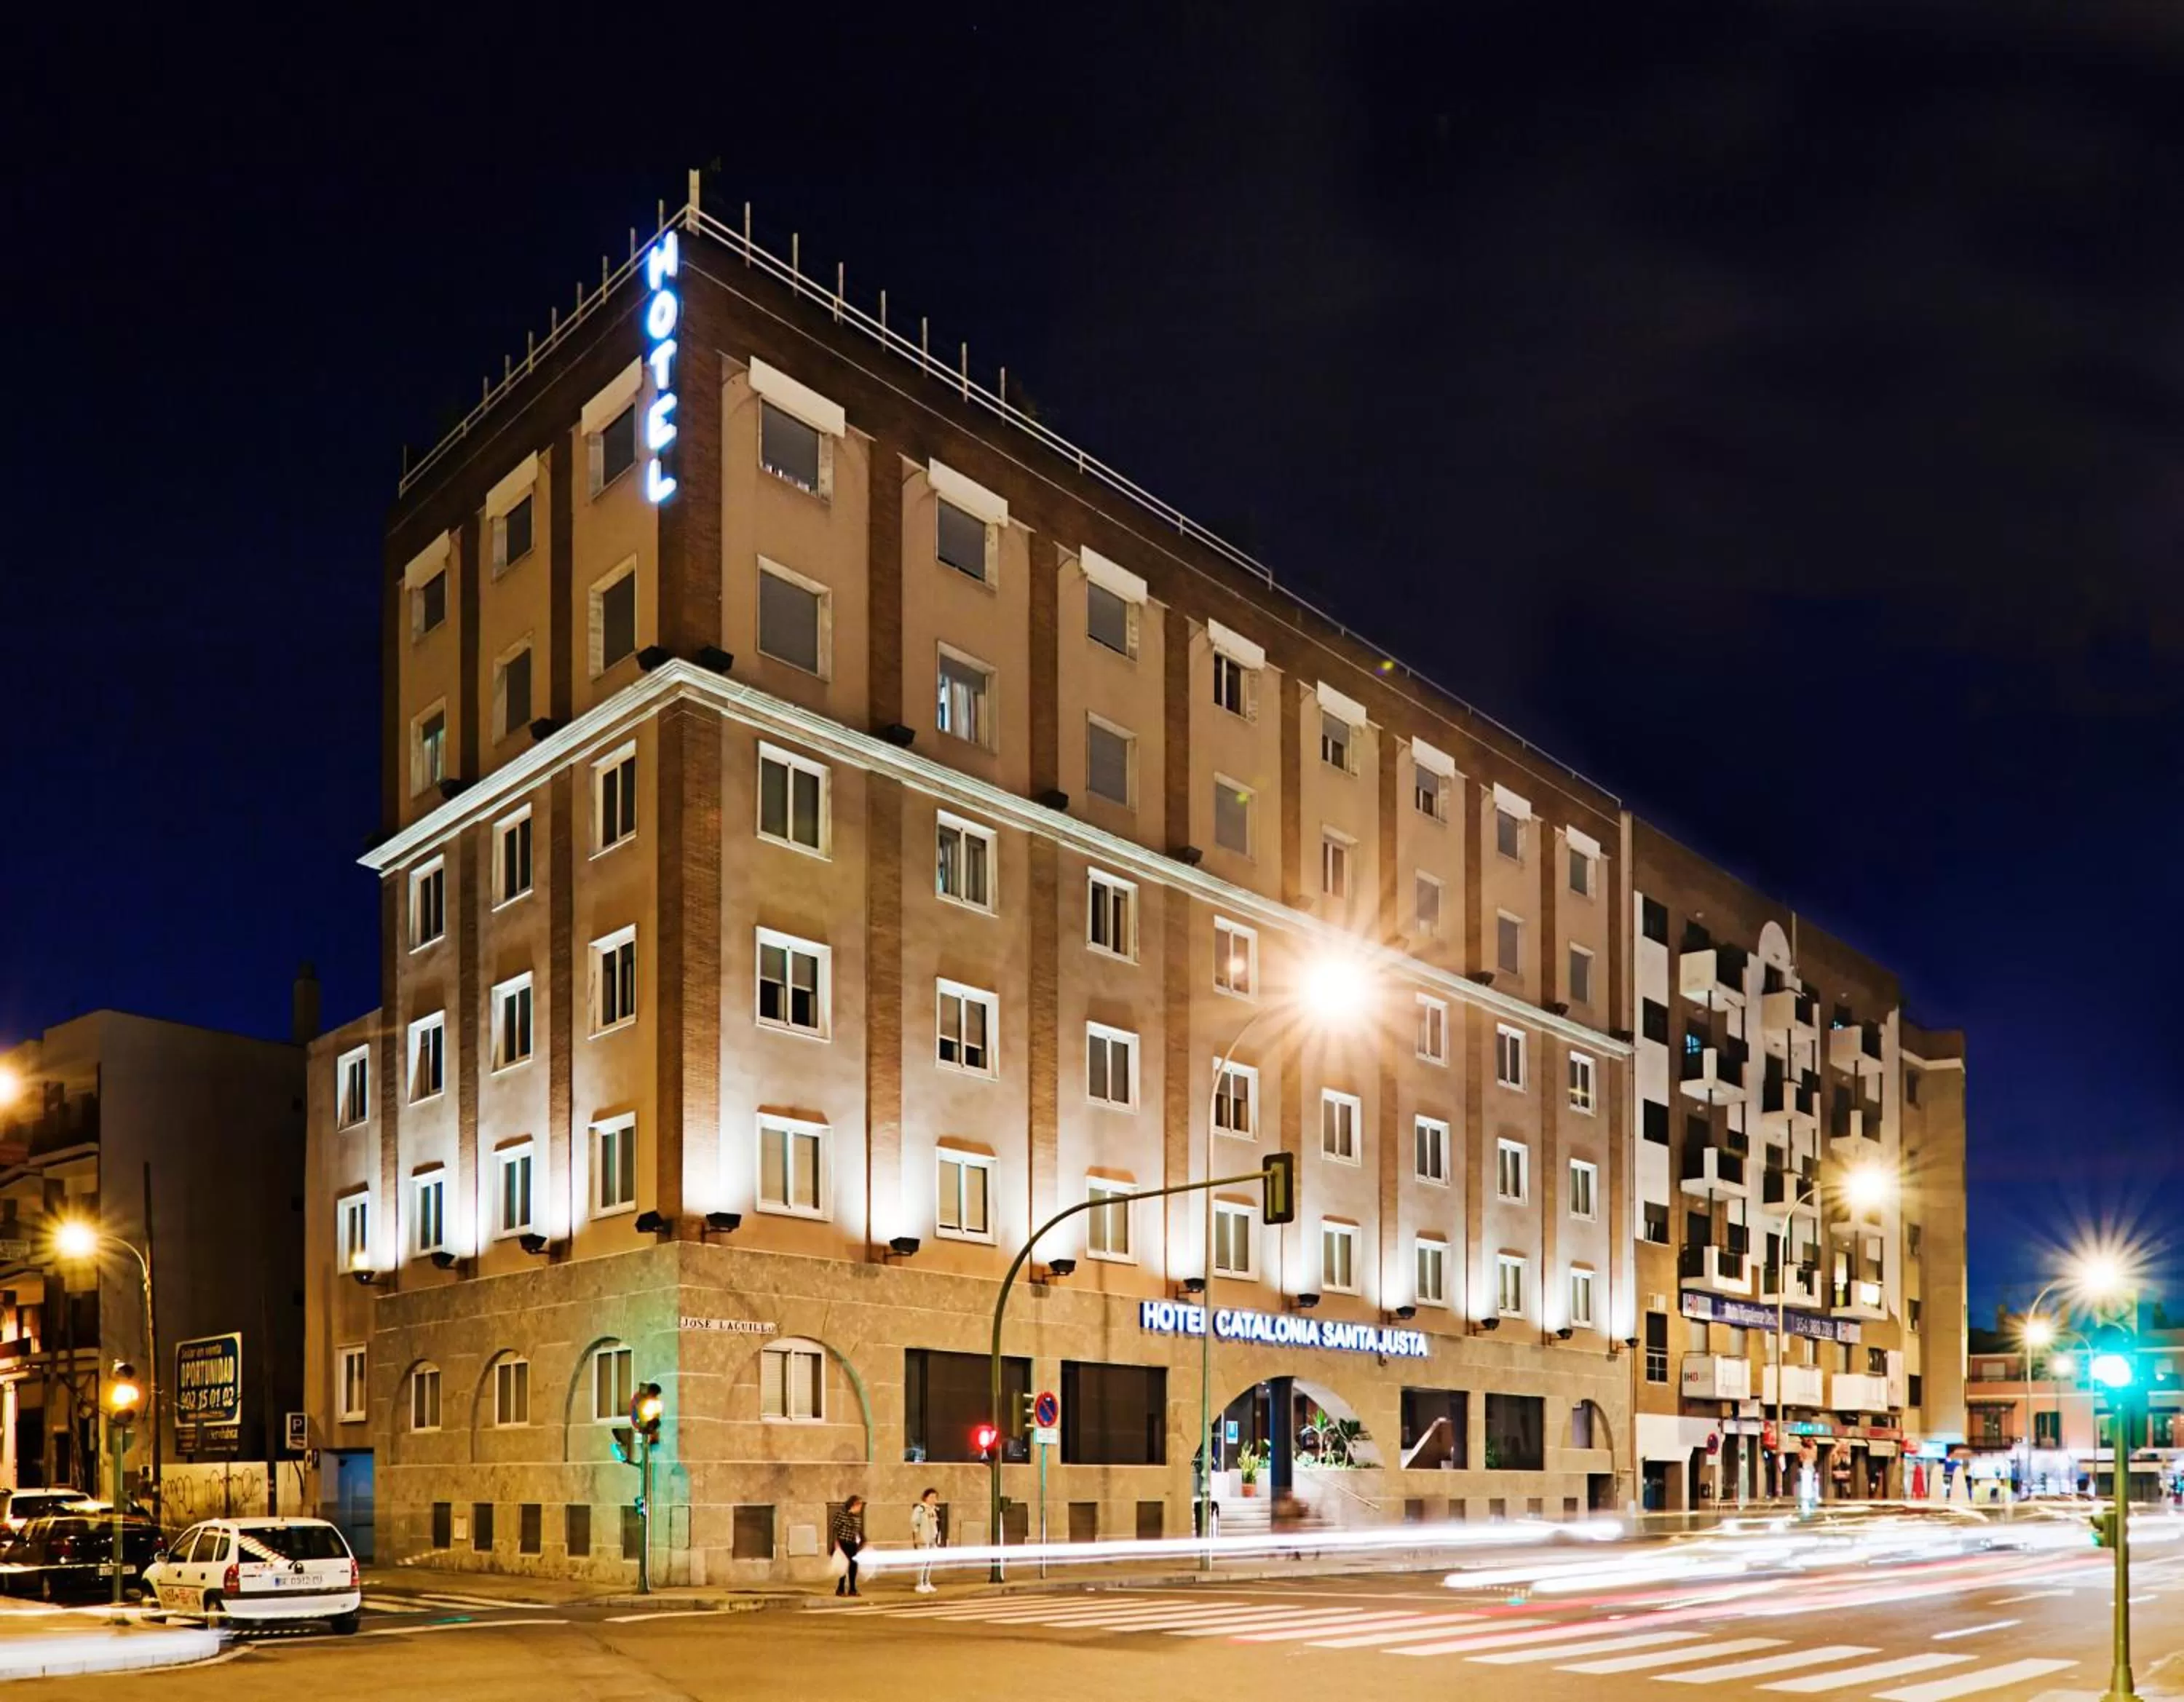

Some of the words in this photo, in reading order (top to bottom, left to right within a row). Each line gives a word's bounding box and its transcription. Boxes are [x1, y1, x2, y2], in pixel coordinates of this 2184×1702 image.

[647, 230, 679, 503] HOTEL
[684, 1318, 711, 1328] JOSE
[1214, 1309, 1320, 1346] CATALONIA
[1321, 1321, 1378, 1352] SANTA
[1378, 1329, 1428, 1357] JUSTA
[181, 1355, 234, 1388] OPORTUNIDAD
[293, 1418, 303, 1431] P
